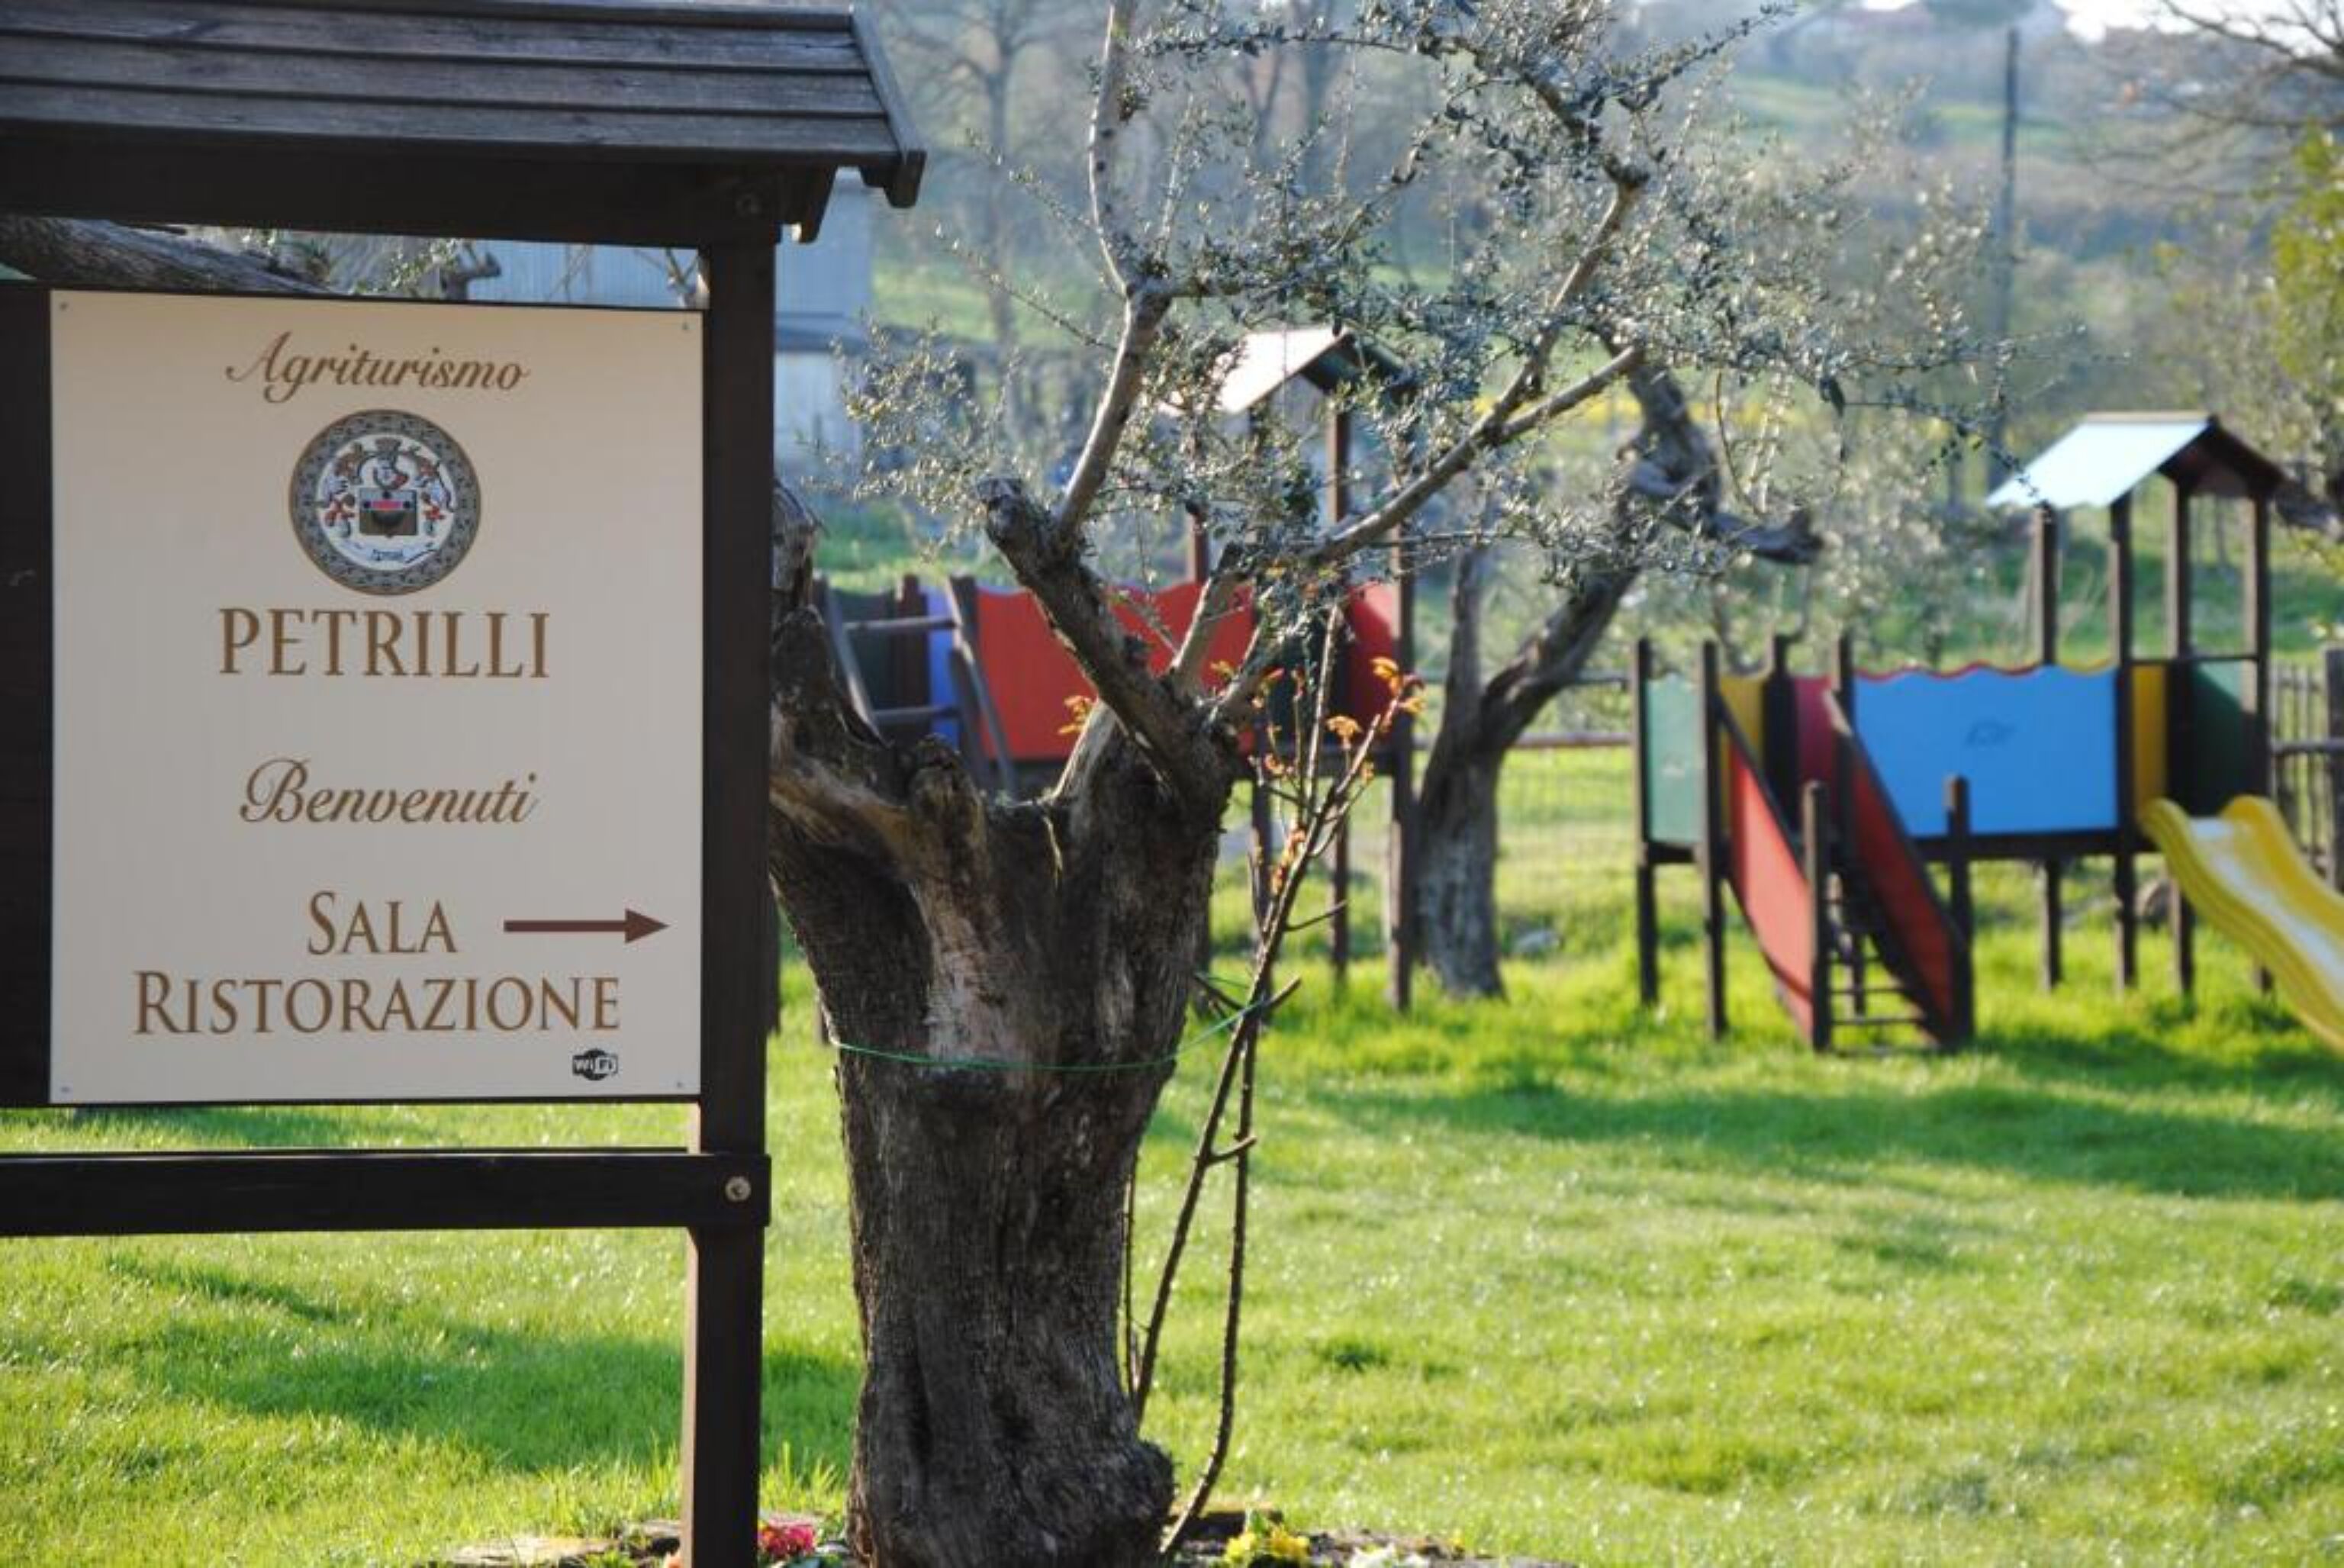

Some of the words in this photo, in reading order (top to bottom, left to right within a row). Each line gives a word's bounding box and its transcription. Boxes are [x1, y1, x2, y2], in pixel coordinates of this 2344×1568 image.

[225, 331, 530, 403] Agriturismo
[219, 607, 549, 678] PETRILLI
[239, 758, 539, 823] Benvenuti
[307, 890, 458, 955] SALA
[134, 971, 620, 1035] RISTORAZIONE
